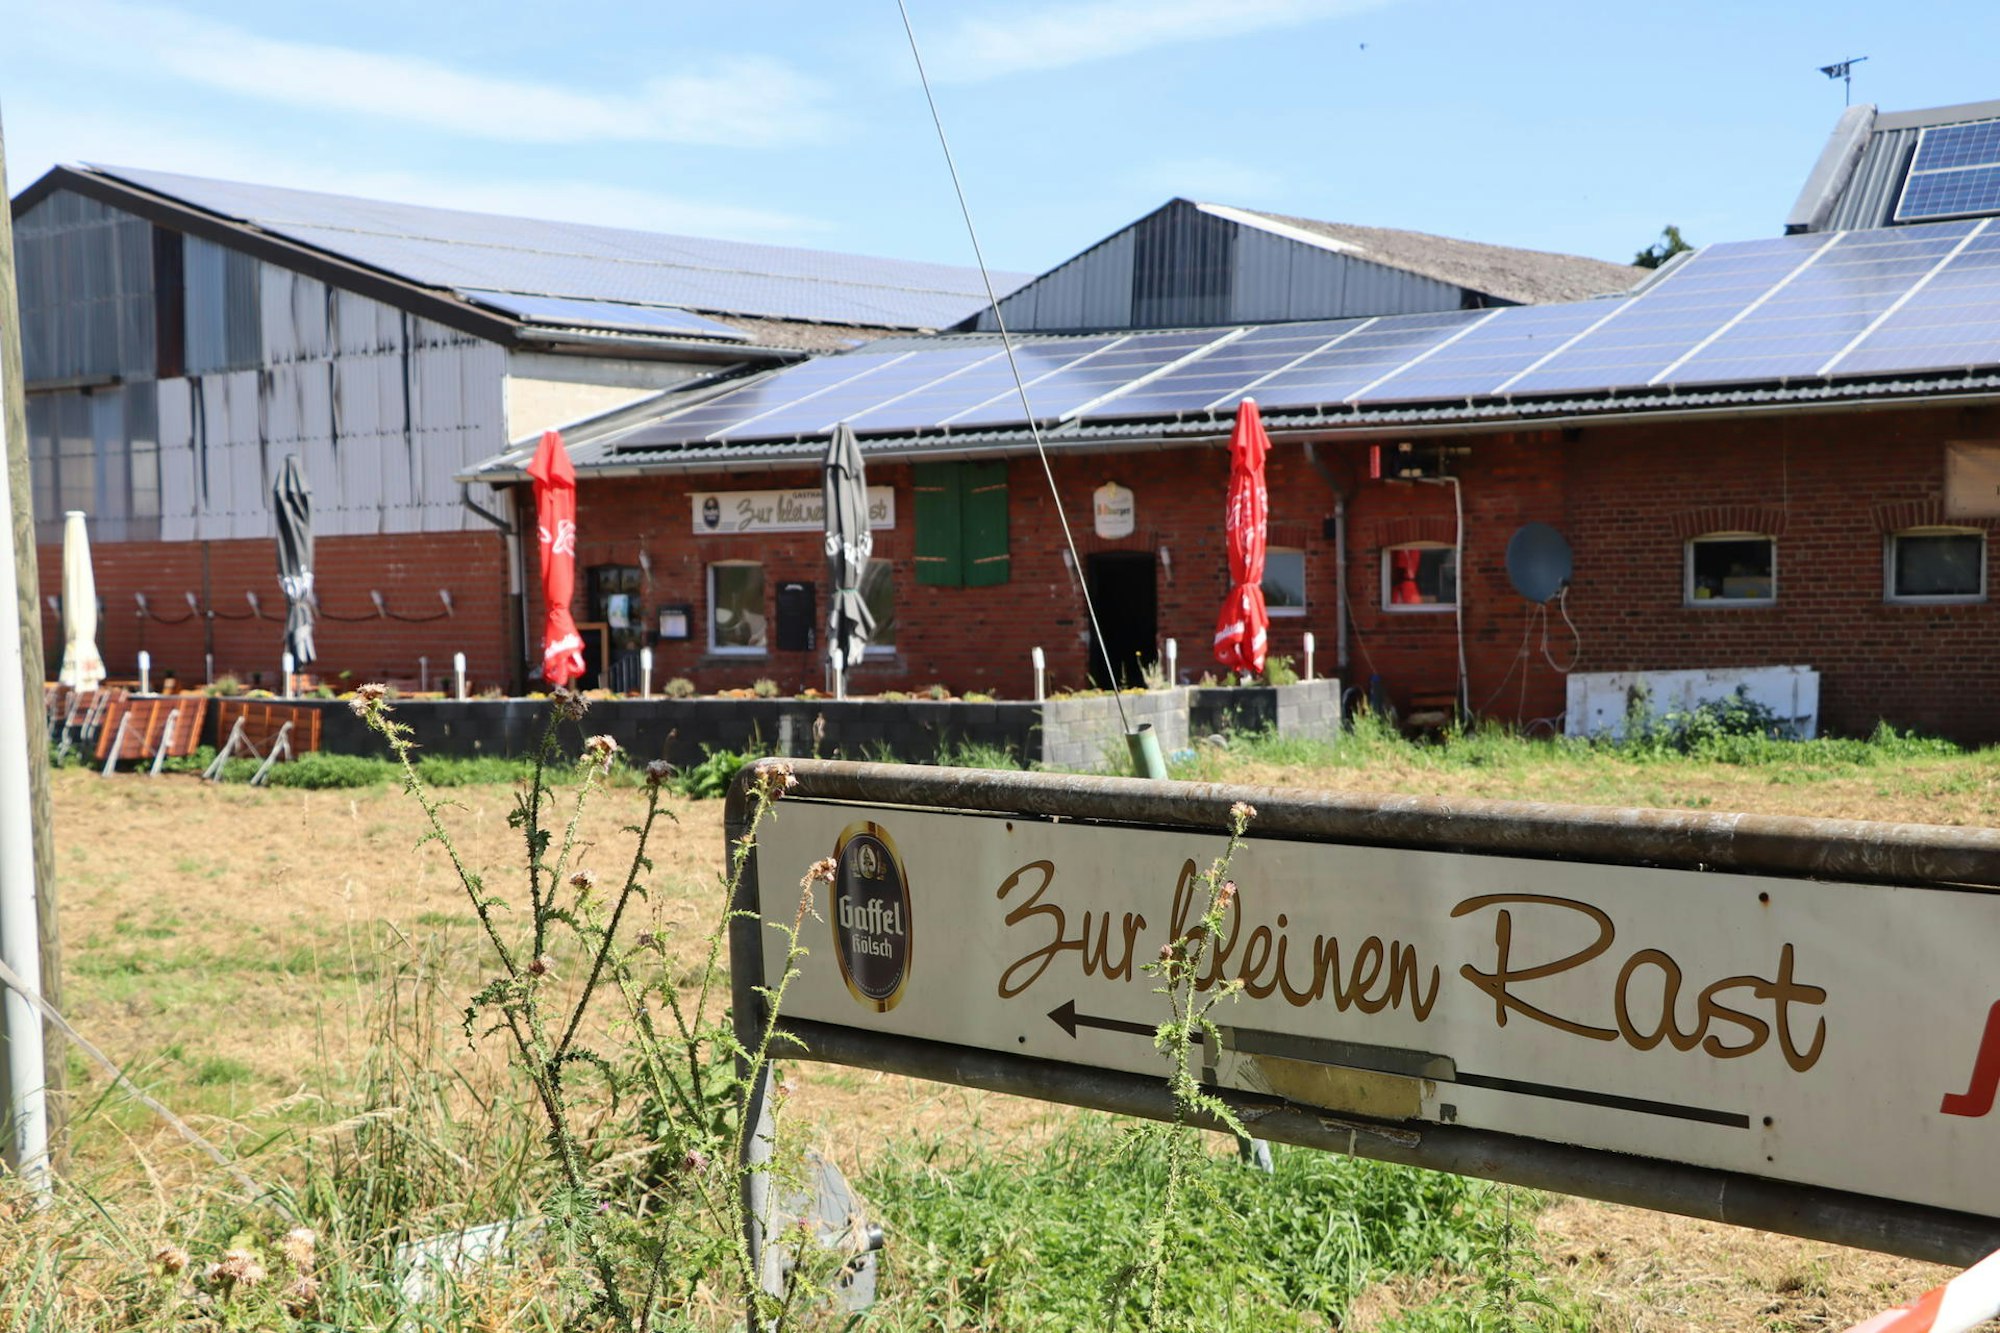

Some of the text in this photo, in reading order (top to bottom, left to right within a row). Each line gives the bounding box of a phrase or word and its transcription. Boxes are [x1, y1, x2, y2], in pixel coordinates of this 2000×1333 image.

[736, 494, 888, 531] Zur kleine st
[791, 490, 823, 499] GASTHA
[839, 894, 904, 936] Gaffel
[852, 933, 893, 959] Kölsch
[996, 859, 1147, 999] Zur
[1169, 857, 1440, 1023] kleinen
[1450, 893, 1827, 1073] Rast
